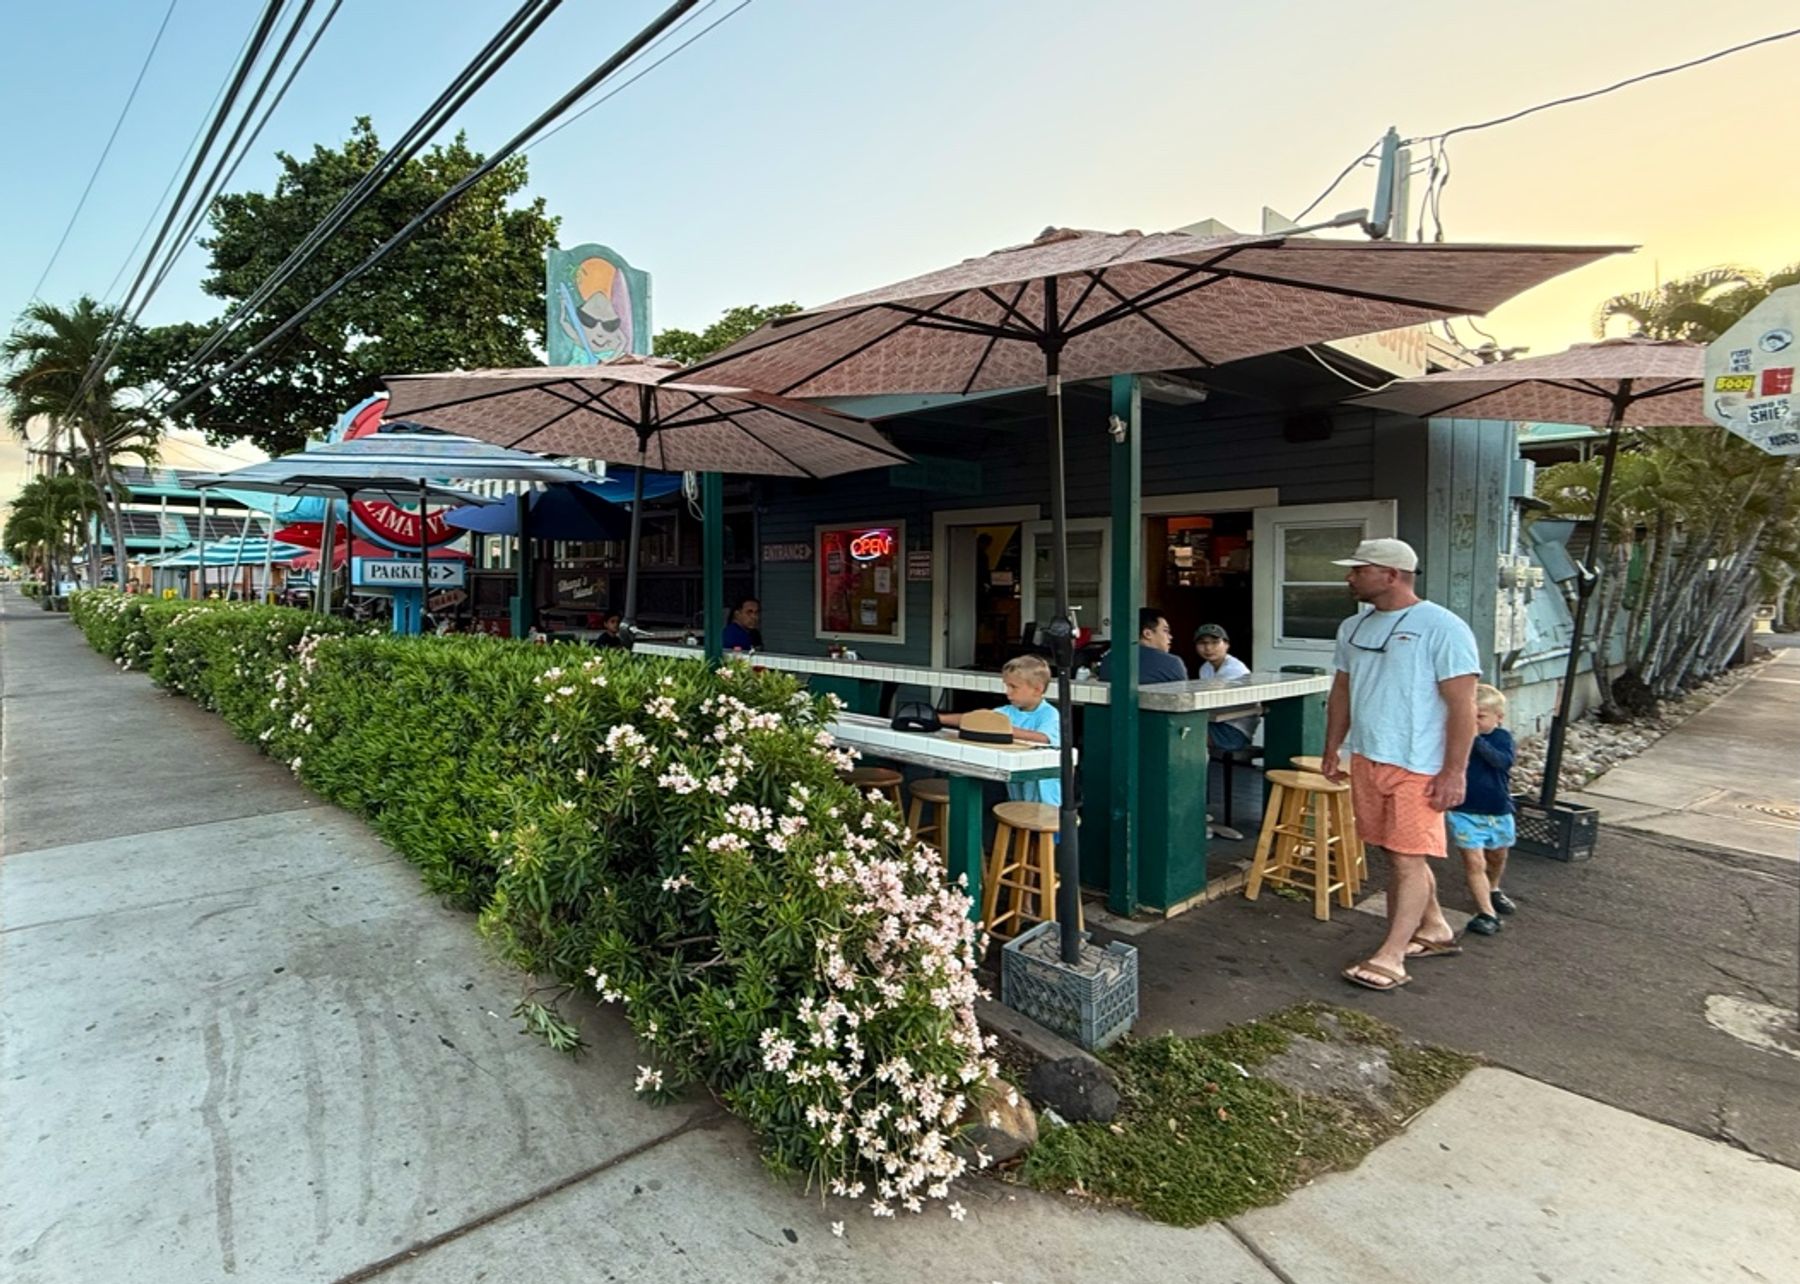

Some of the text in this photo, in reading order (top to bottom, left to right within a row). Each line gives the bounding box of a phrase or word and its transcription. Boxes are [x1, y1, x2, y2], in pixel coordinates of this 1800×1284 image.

[763, 544, 805, 560] ENTRANCE
[851, 538, 890, 555] OPEN
[371, 564, 438, 579] PARKIG
